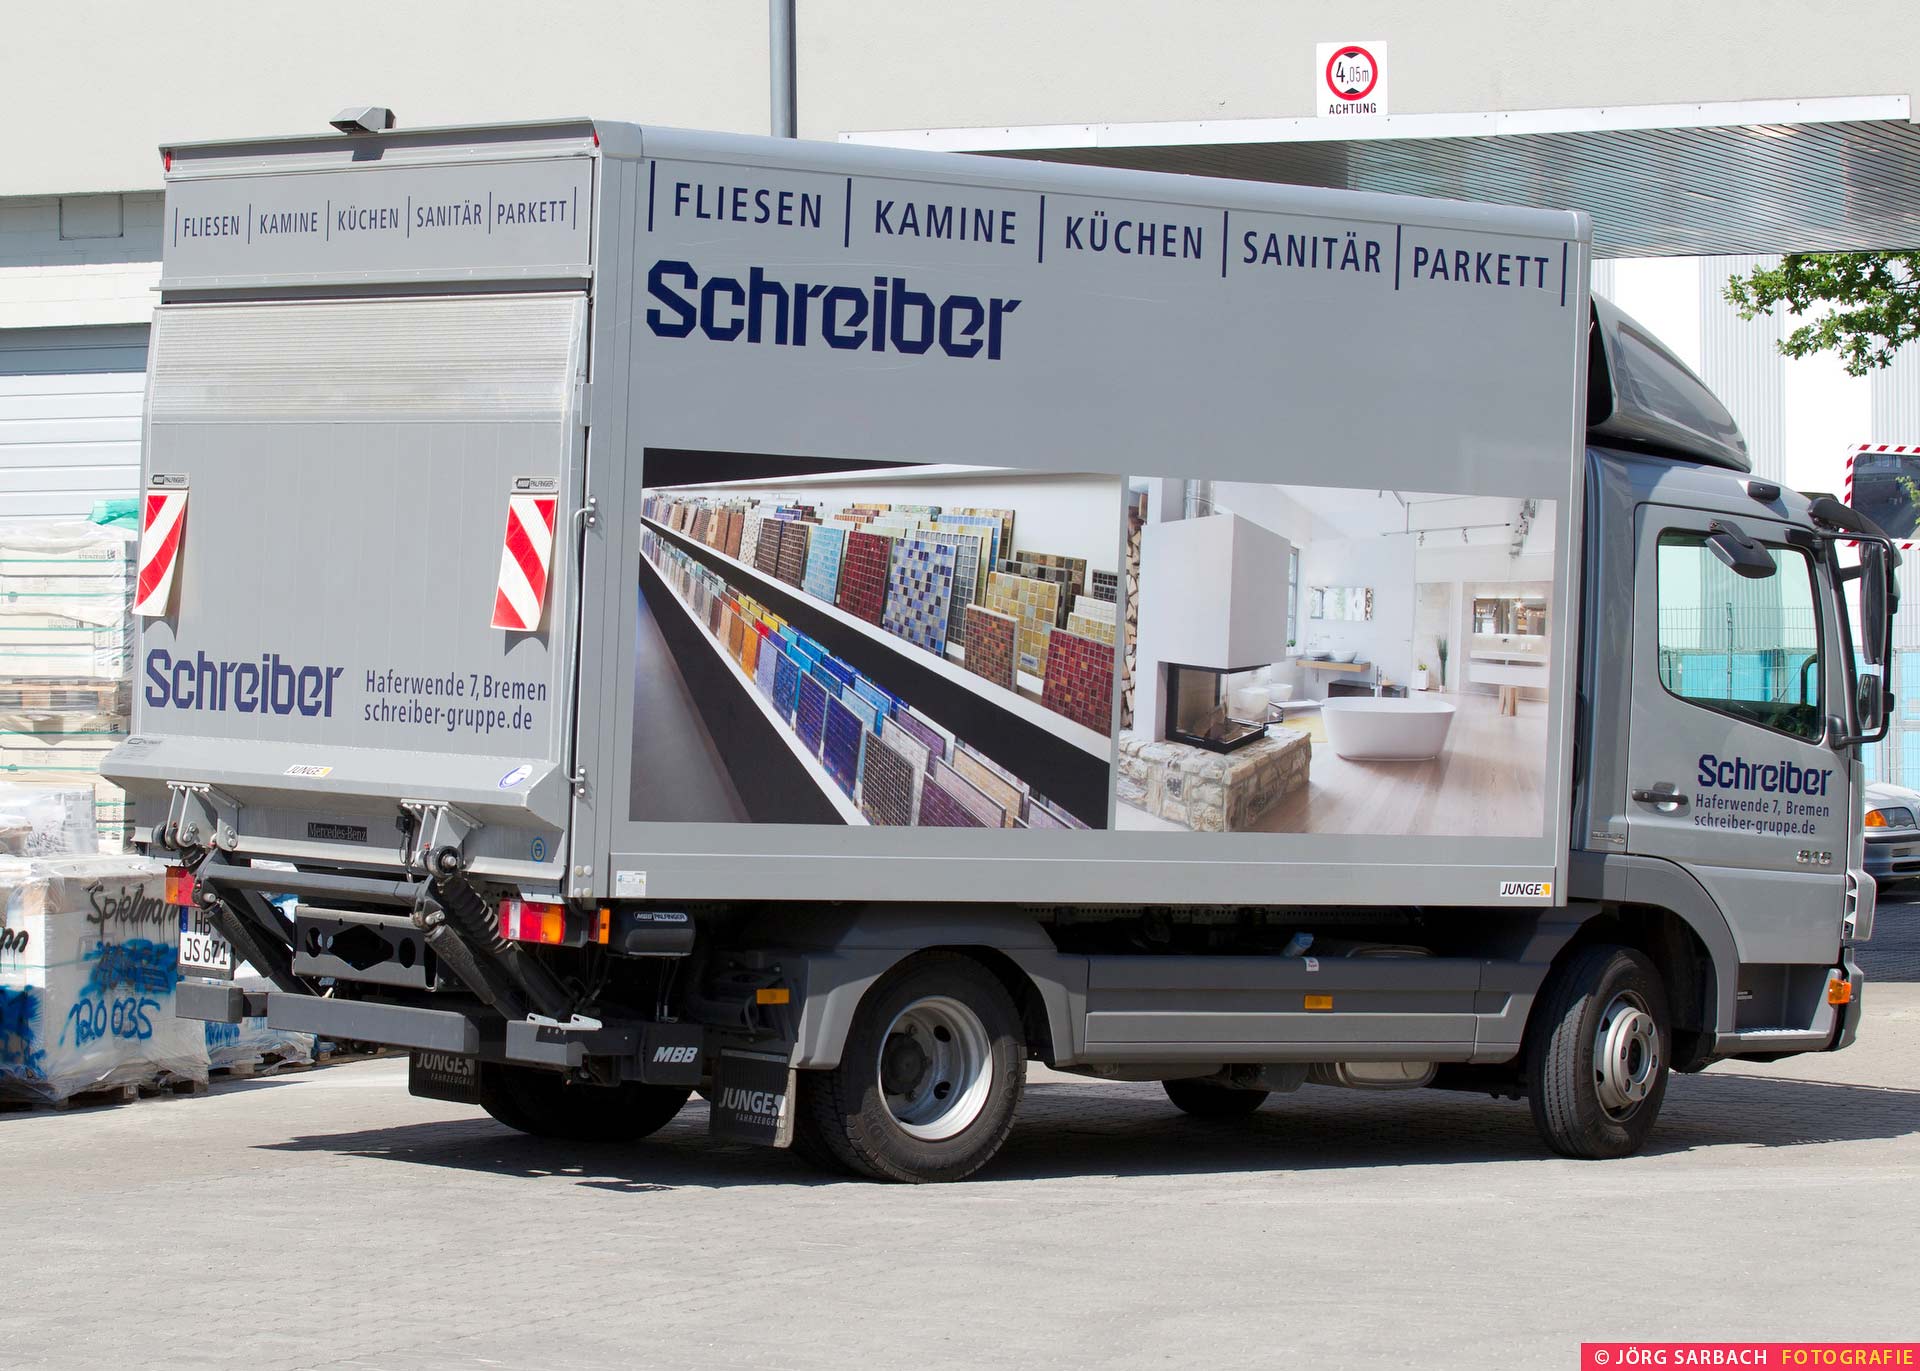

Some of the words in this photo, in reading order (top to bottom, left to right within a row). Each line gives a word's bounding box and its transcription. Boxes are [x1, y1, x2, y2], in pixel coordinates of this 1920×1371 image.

[1335, 61, 1369, 84] 4,05m
[1328, 103, 1377, 115] ACHTUNG
[183, 215, 240, 238] FLIESEN
[259, 212, 318, 235] KAMINE
[337, 205, 399, 231] KÜCHEN
[416, 200, 482, 228] SANITÄR
[497, 200, 568, 225] PARKETT
[674, 182, 822, 229] FLIESEN
[874, 199, 1017, 245] KAMINE
[1065, 210, 1203, 260] KÜCHEN
[1243, 231, 1381, 274] SANITÄR
[1413, 246, 1550, 289] PARKETT
[646, 259, 1023, 361] Schreiber
[145, 648, 345, 717] Schreiber
[365, 669, 465, 698] Haferwende
[364, 697, 533, 735] schreiber-gruppe.de
[1697, 753, 1833, 797] Schreiber
[1695, 793, 1770, 814] Haferwende
[1786, 801, 1830, 817] Bremen
[309, 823, 367, 841] Mercedes-Benz
[1694, 811, 1816, 836] schreiber-gruppe.de
[1501, 883, 1542, 896] JUNGE
[184, 938, 200, 962] JS
[204, 940, 228, 965] 671
[652, 1046, 699, 1063] MBB
[718, 1087, 775, 1115] JUNGE
